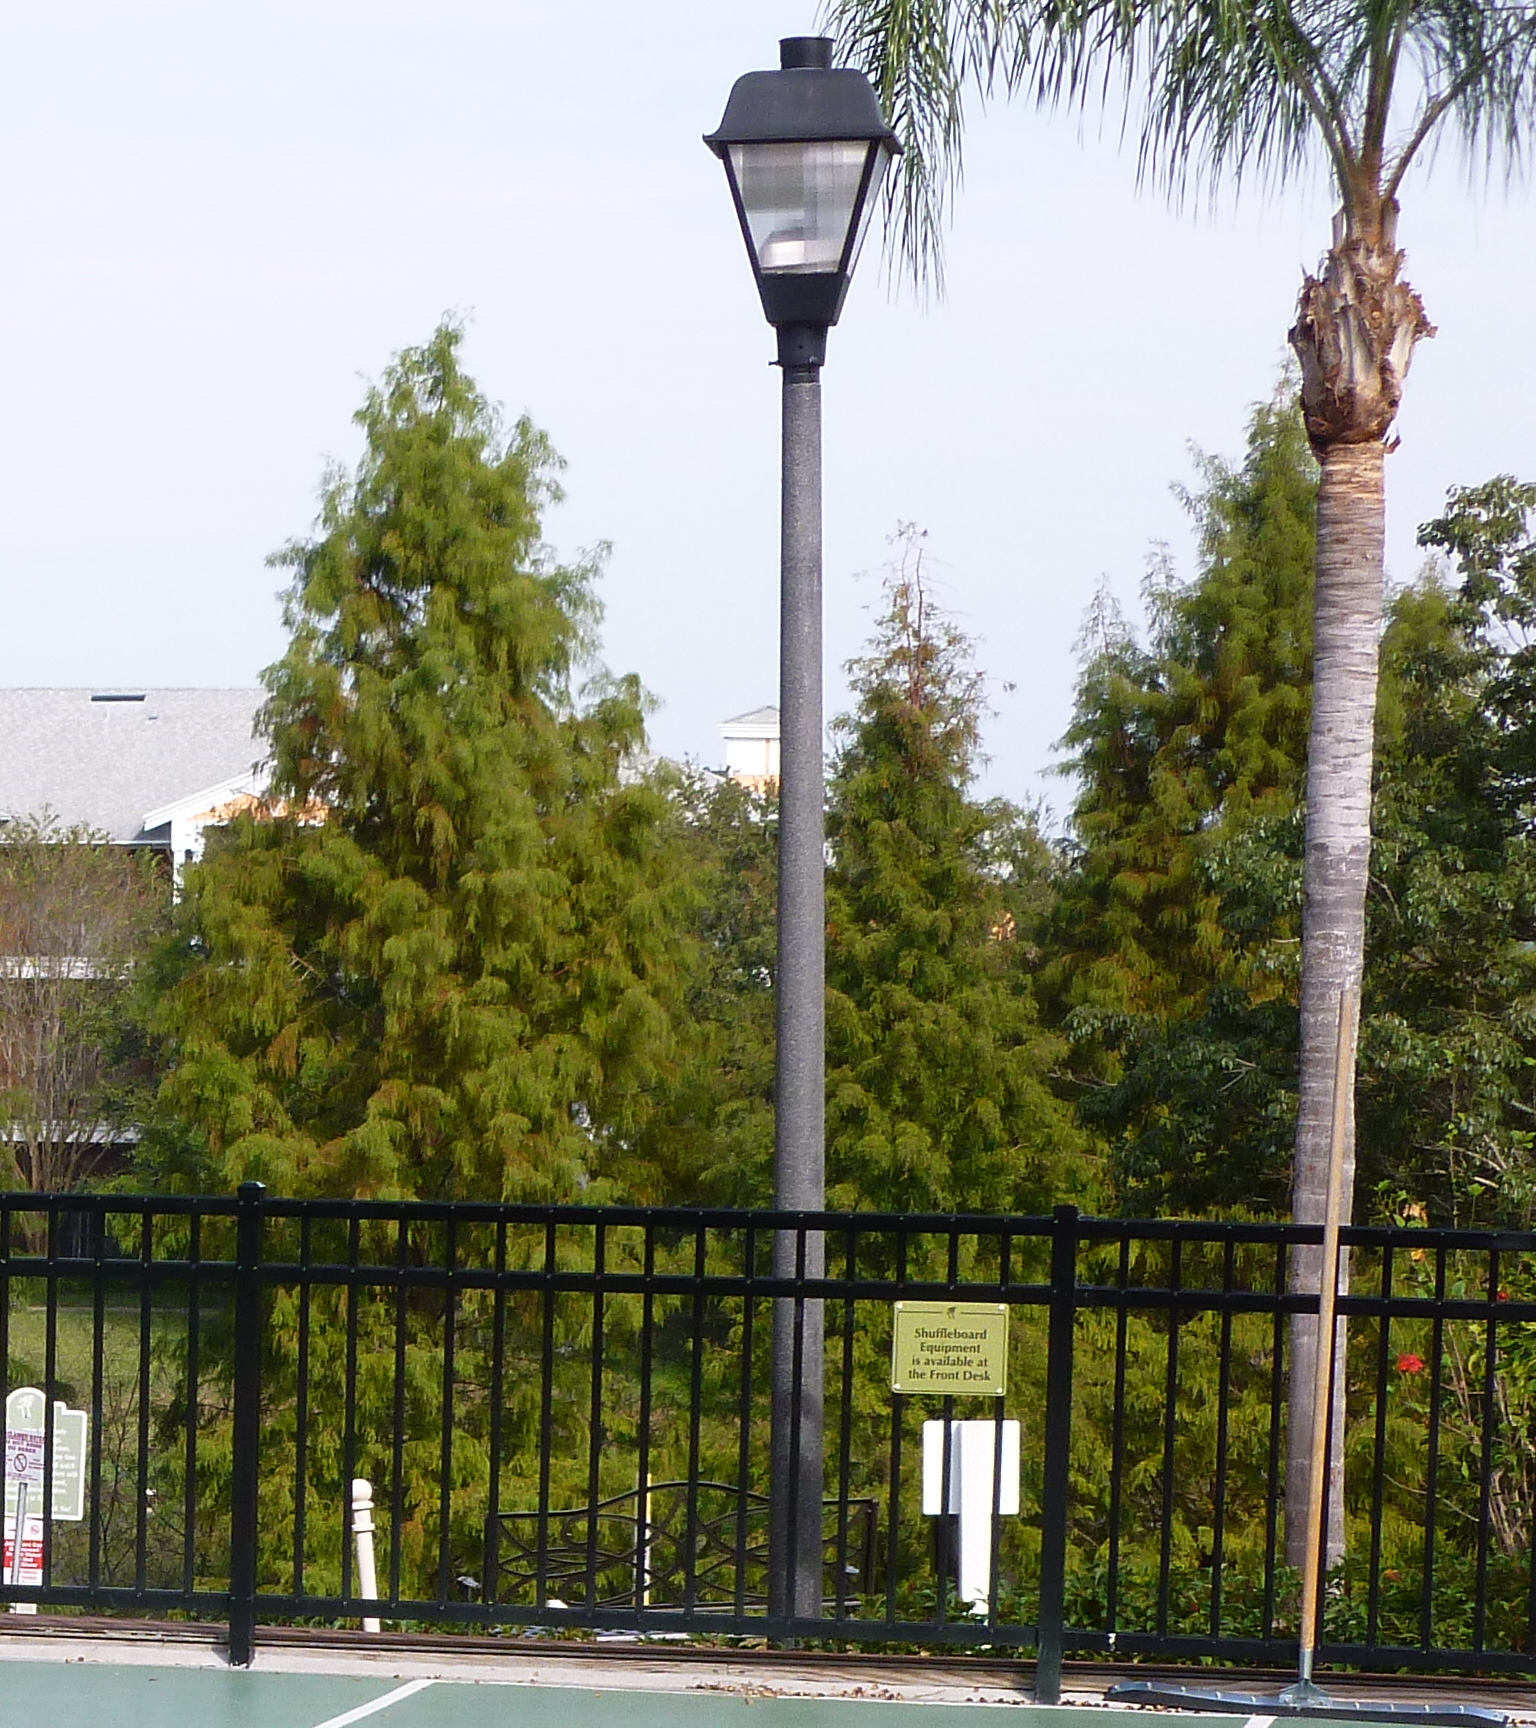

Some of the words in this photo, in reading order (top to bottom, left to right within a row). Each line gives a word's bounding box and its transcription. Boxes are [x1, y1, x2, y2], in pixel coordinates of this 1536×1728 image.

[914, 1328, 987, 1340] Shuffleboard
[920, 1342, 980, 1355] Equipment
[912, 1355, 921, 1366] is
[923, 1355, 974, 1367] available
[976, 1358, 988, 1368] at
[908, 1368, 926, 1380] the
[929, 1369, 960, 1381] Front
[963, 1369, 991, 1381] Desk
